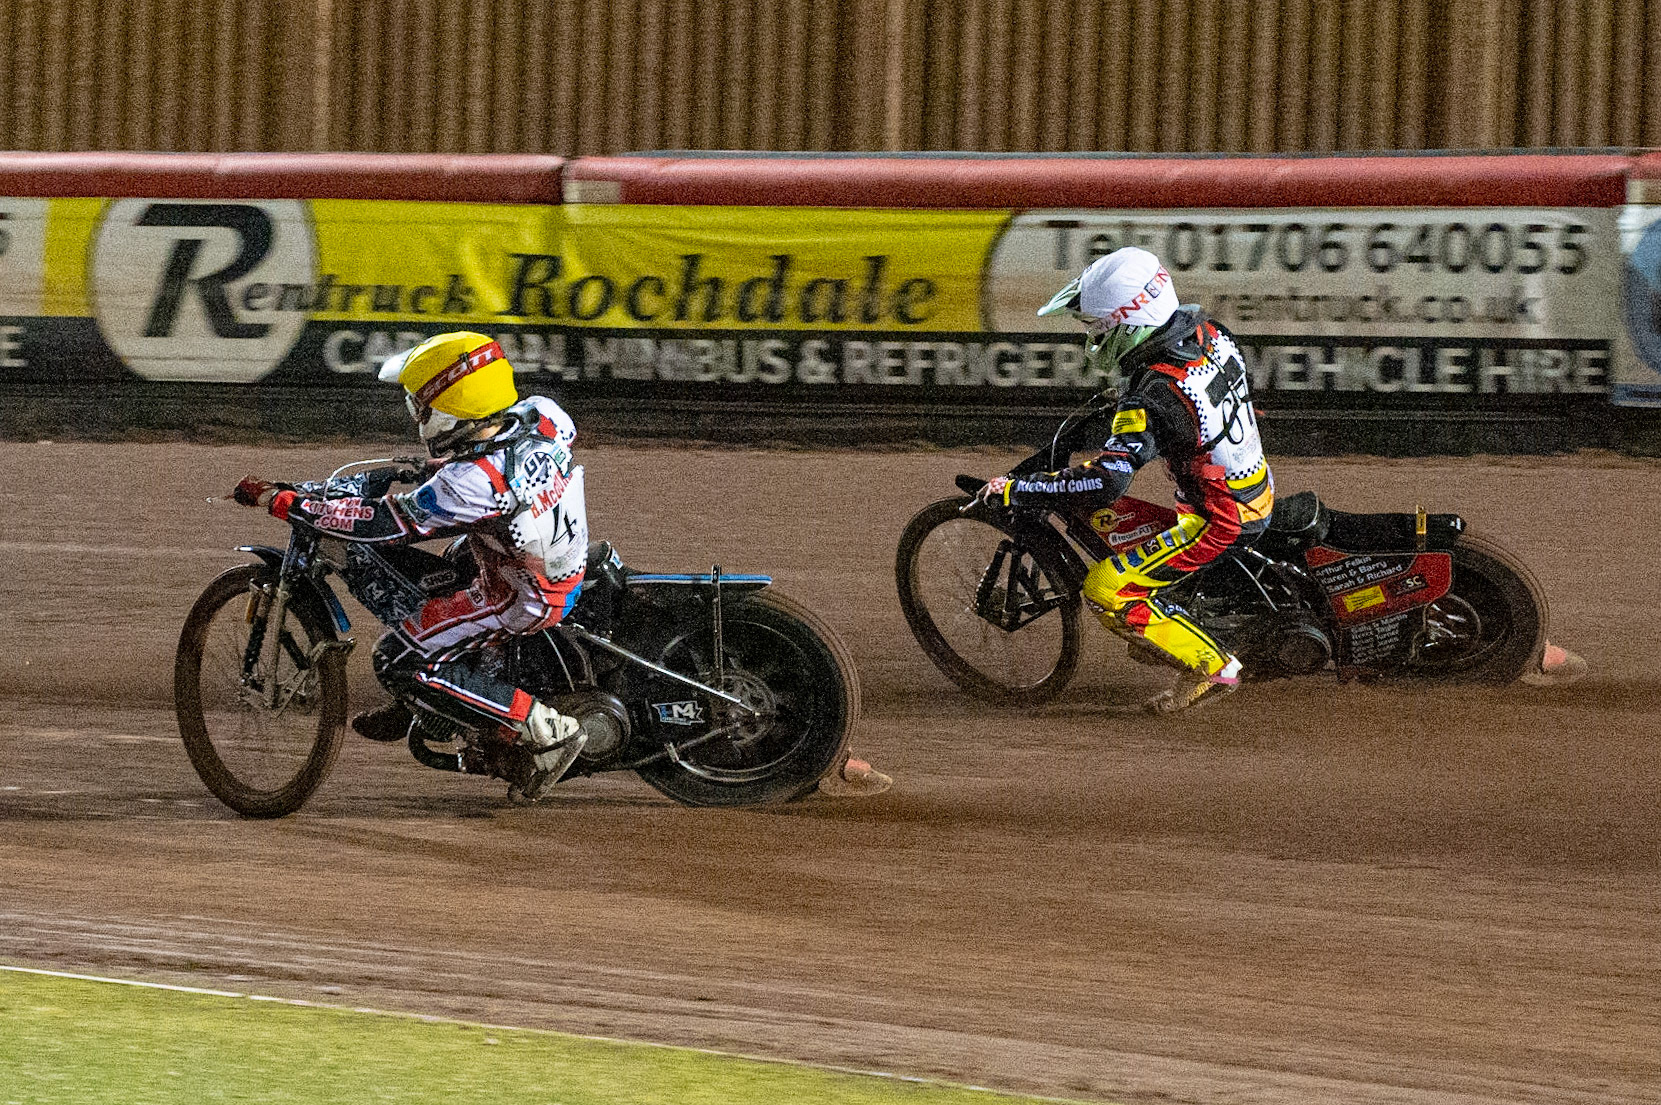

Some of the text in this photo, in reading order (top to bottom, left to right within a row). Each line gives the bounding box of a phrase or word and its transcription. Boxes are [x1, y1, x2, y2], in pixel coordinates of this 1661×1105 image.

[1163, 222, 1348, 272] 01706
[1366, 222, 1588, 273] 640055
[497, 254, 938, 324] Rochdale
[422, 348, 493, 402] SCOTT
[797, 340, 838, 384] &
[1479, 348, 1609, 394] HIRE
[550, 502, 577, 546] 4
[1316, 563, 1345, 577] Arthur
[1321, 561, 1388, 585] Karen & Barry
[1326, 563, 1403, 594] Sarah & Richard
